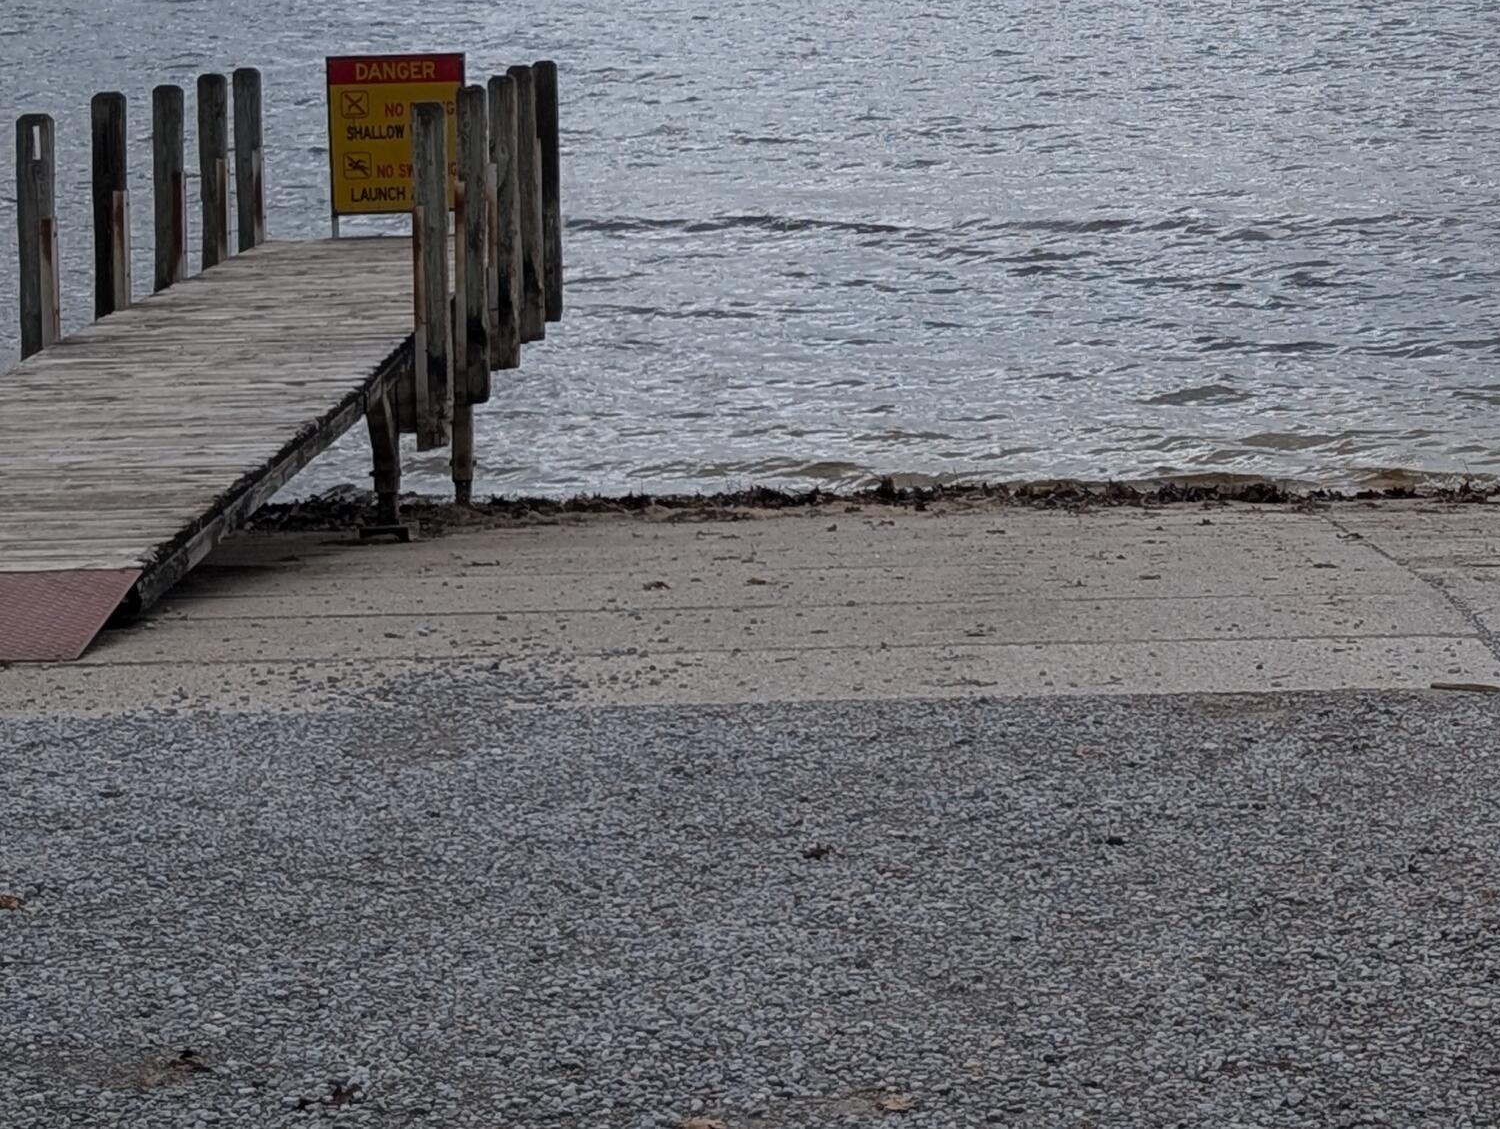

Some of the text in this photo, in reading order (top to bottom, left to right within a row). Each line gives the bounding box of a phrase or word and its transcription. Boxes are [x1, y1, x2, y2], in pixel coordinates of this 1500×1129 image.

[355, 61, 435, 81] DANGER
[384, 102, 404, 118] NO
[346, 124, 404, 140] SHALLOW
[376, 164, 394, 179] NO
[351, 187, 406, 202] LAUNCH
